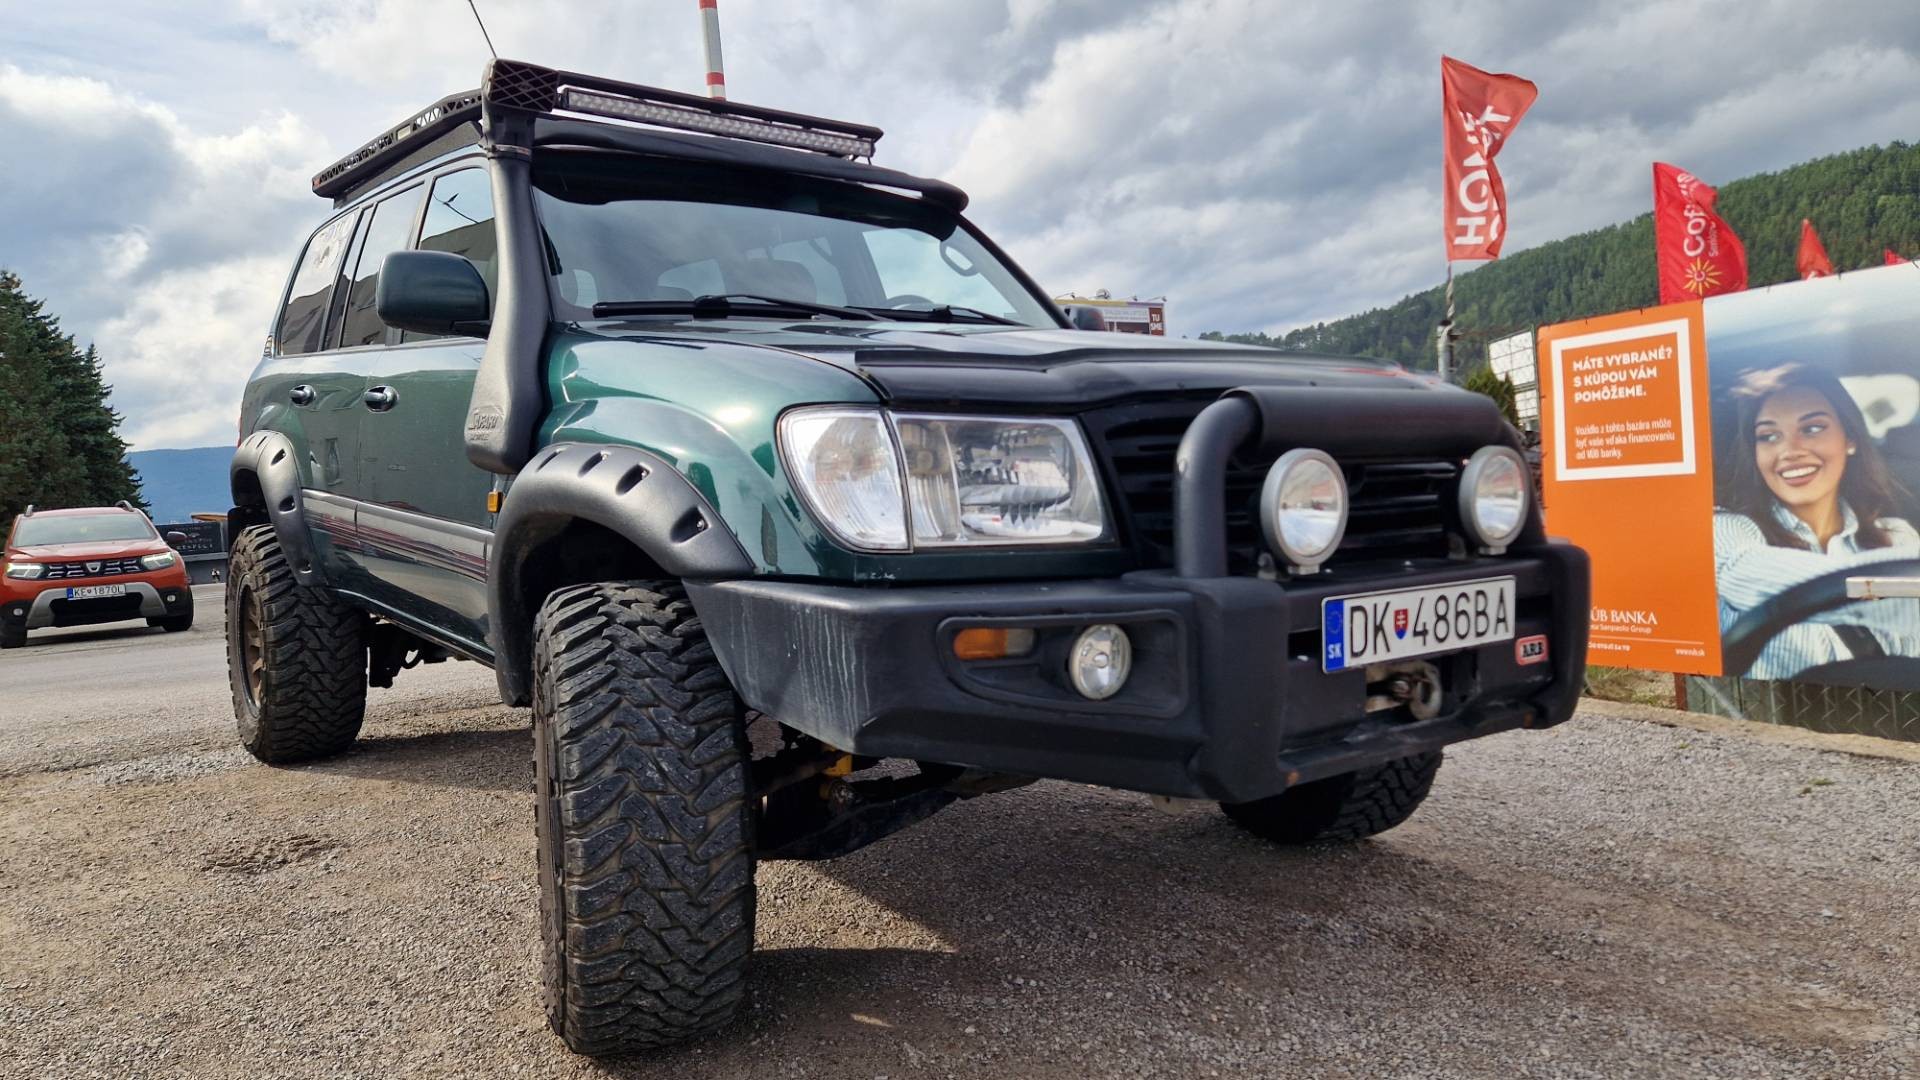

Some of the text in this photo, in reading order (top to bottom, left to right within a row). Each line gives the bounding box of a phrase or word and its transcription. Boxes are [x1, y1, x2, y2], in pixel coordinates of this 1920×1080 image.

[1572, 345, 1672, 372] MÁTE VYBRANÉ?
[1573, 365, 1657, 388] S KÚPOU VÁM
[1574, 384, 1647, 403] POMÔŽEME.
[1575, 423, 1599, 435] Vozidlo
[1605, 421, 1625, 433] tohto
[75, 587, 87, 597] KE
[1350, 587, 1509, 658] DK 486BA
[1590, 606, 1658, 625] ÚB BANKA
[1328, 643, 1342, 659] SK
